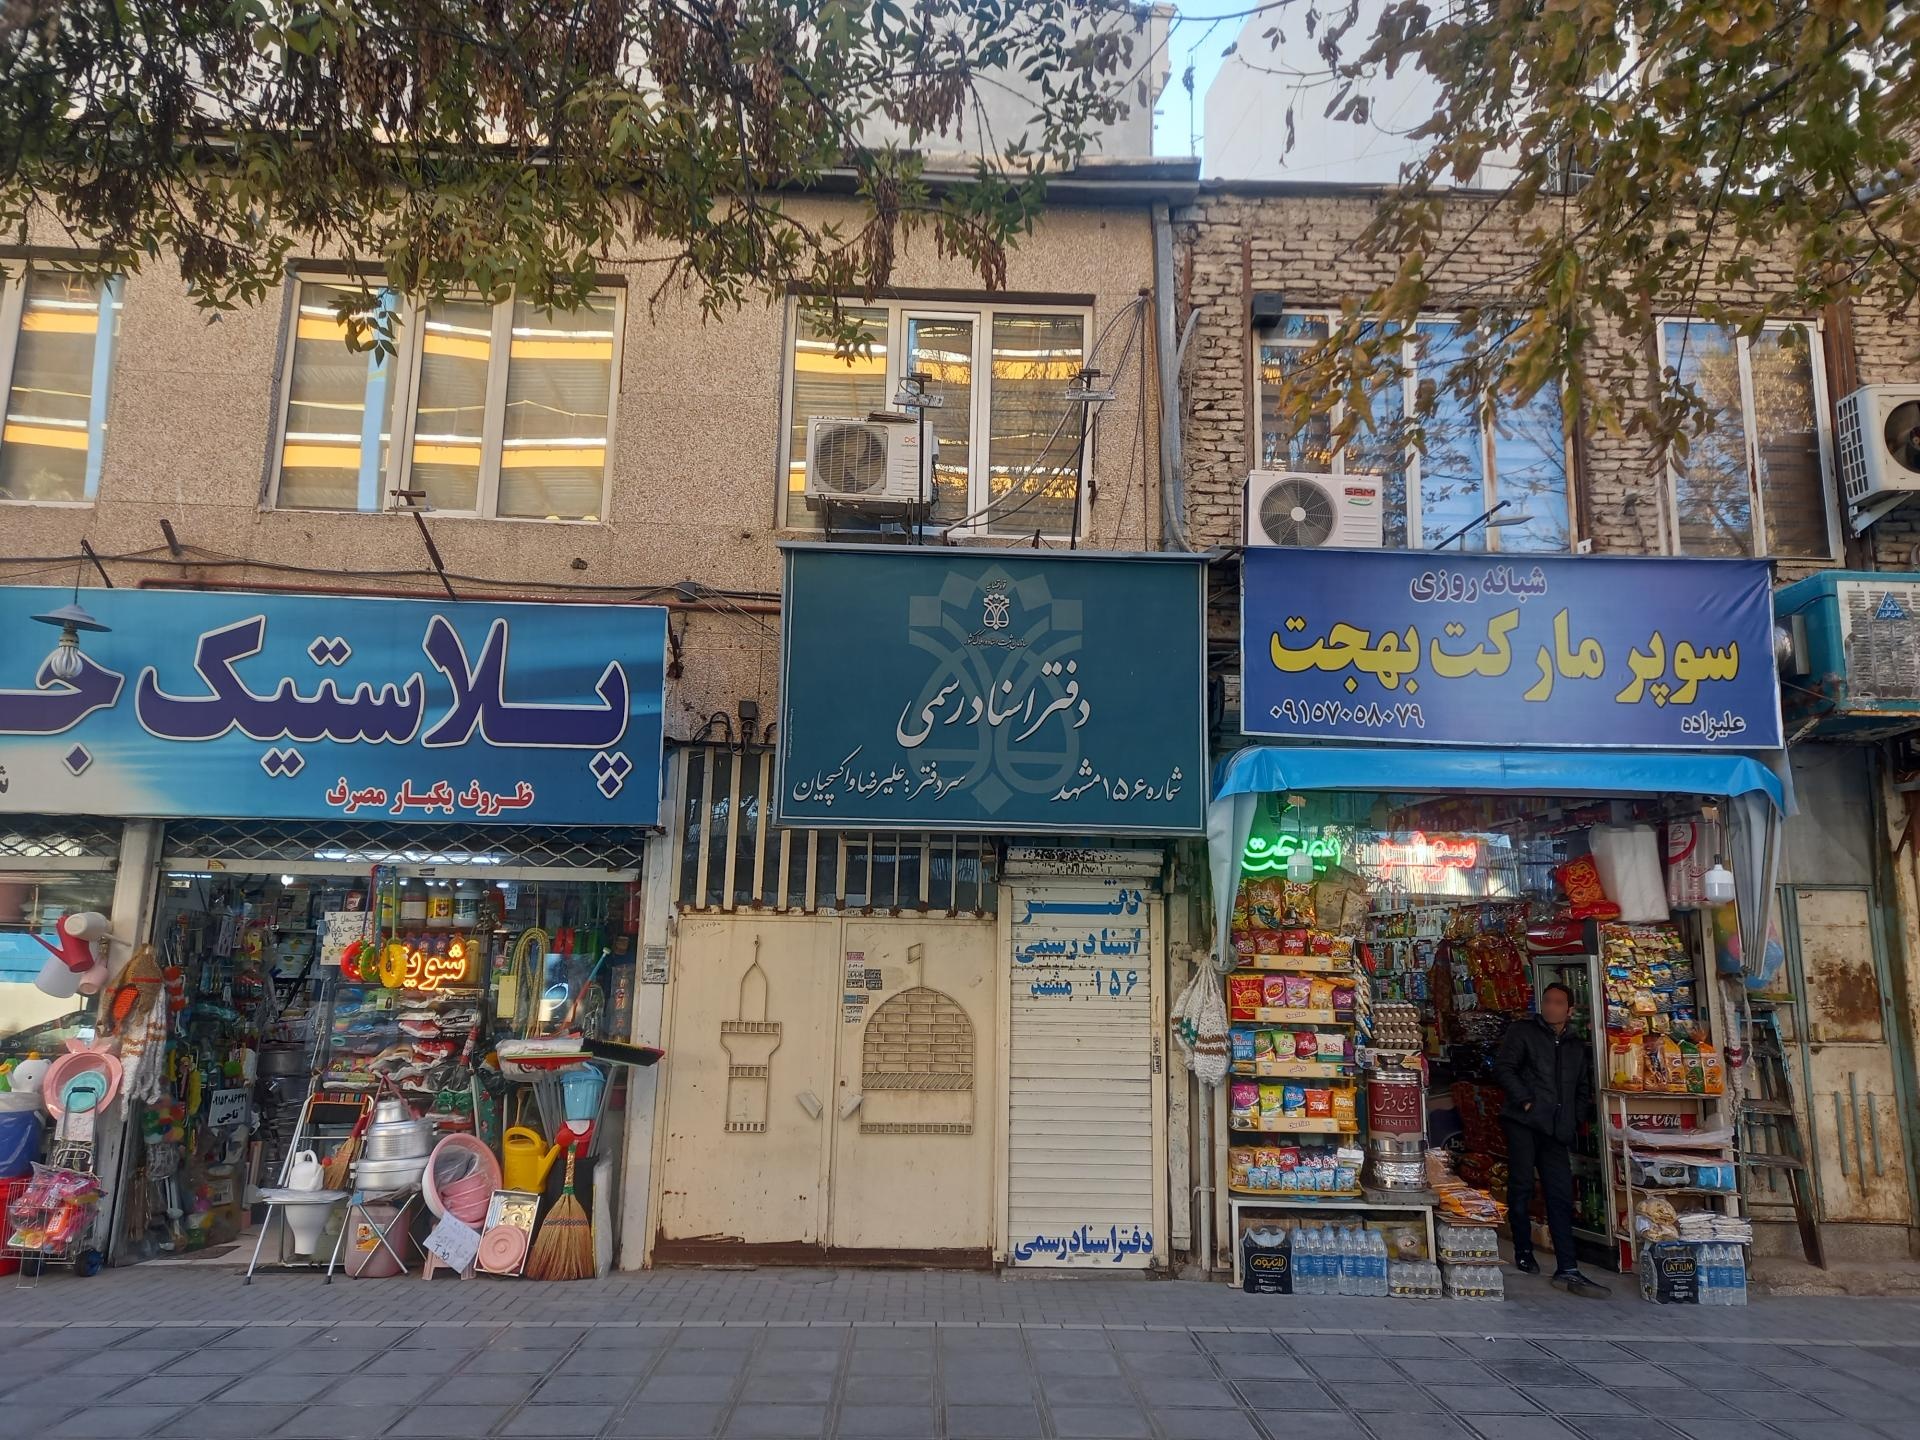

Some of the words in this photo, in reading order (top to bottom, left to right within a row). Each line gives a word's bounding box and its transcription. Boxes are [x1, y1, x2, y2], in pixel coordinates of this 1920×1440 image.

[1408, 568, 1479, 603] روزی
[1480, 565, 1548, 598] شبانه
[1269, 615, 1421, 695] بهجت
[1428, 608, 1606, 702] مارکت
[1614, 630, 1740, 708] سوپر
[134, 613, 633, 799] پلاستیک
[896, 680, 965, 748] رسمی
[966, 679, 1036, 728] اسناد
[1016, 659, 1091, 743] دفتر
[1270, 698, 1425, 729] ۰۹۱۵۷۰۵۸۰۷۹
[1680, 710, 1748, 742] علیزاده
[326, 776, 388, 814] مصرف
[388, 778, 455, 816] یکبار
[458, 779, 535, 816] ظروف
[856, 761, 907, 800] علیرضا
[1049, 758, 1101, 801] مشهد
[1102, 777, 1148, 801] ۱۵۶
[1145, 766, 1183, 801] شماره
[1021, 879, 1144, 926] دفتر
[1015, 938, 1078, 963] رسمی
[1082, 928, 1142, 956] اسناد
[1031, 971, 1073, 996] مشهد
[1094, 968, 1138, 997] ۱۵۶
[1374, 1087, 1397, 1112] دبش
[1015, 1234, 1068, 1261] رسمی
[1069, 1224, 1118, 1254] اسناد
[1112, 1224, 1154, 1263] دفتر
[1665, 1262, 1693, 1272] LATIUM
